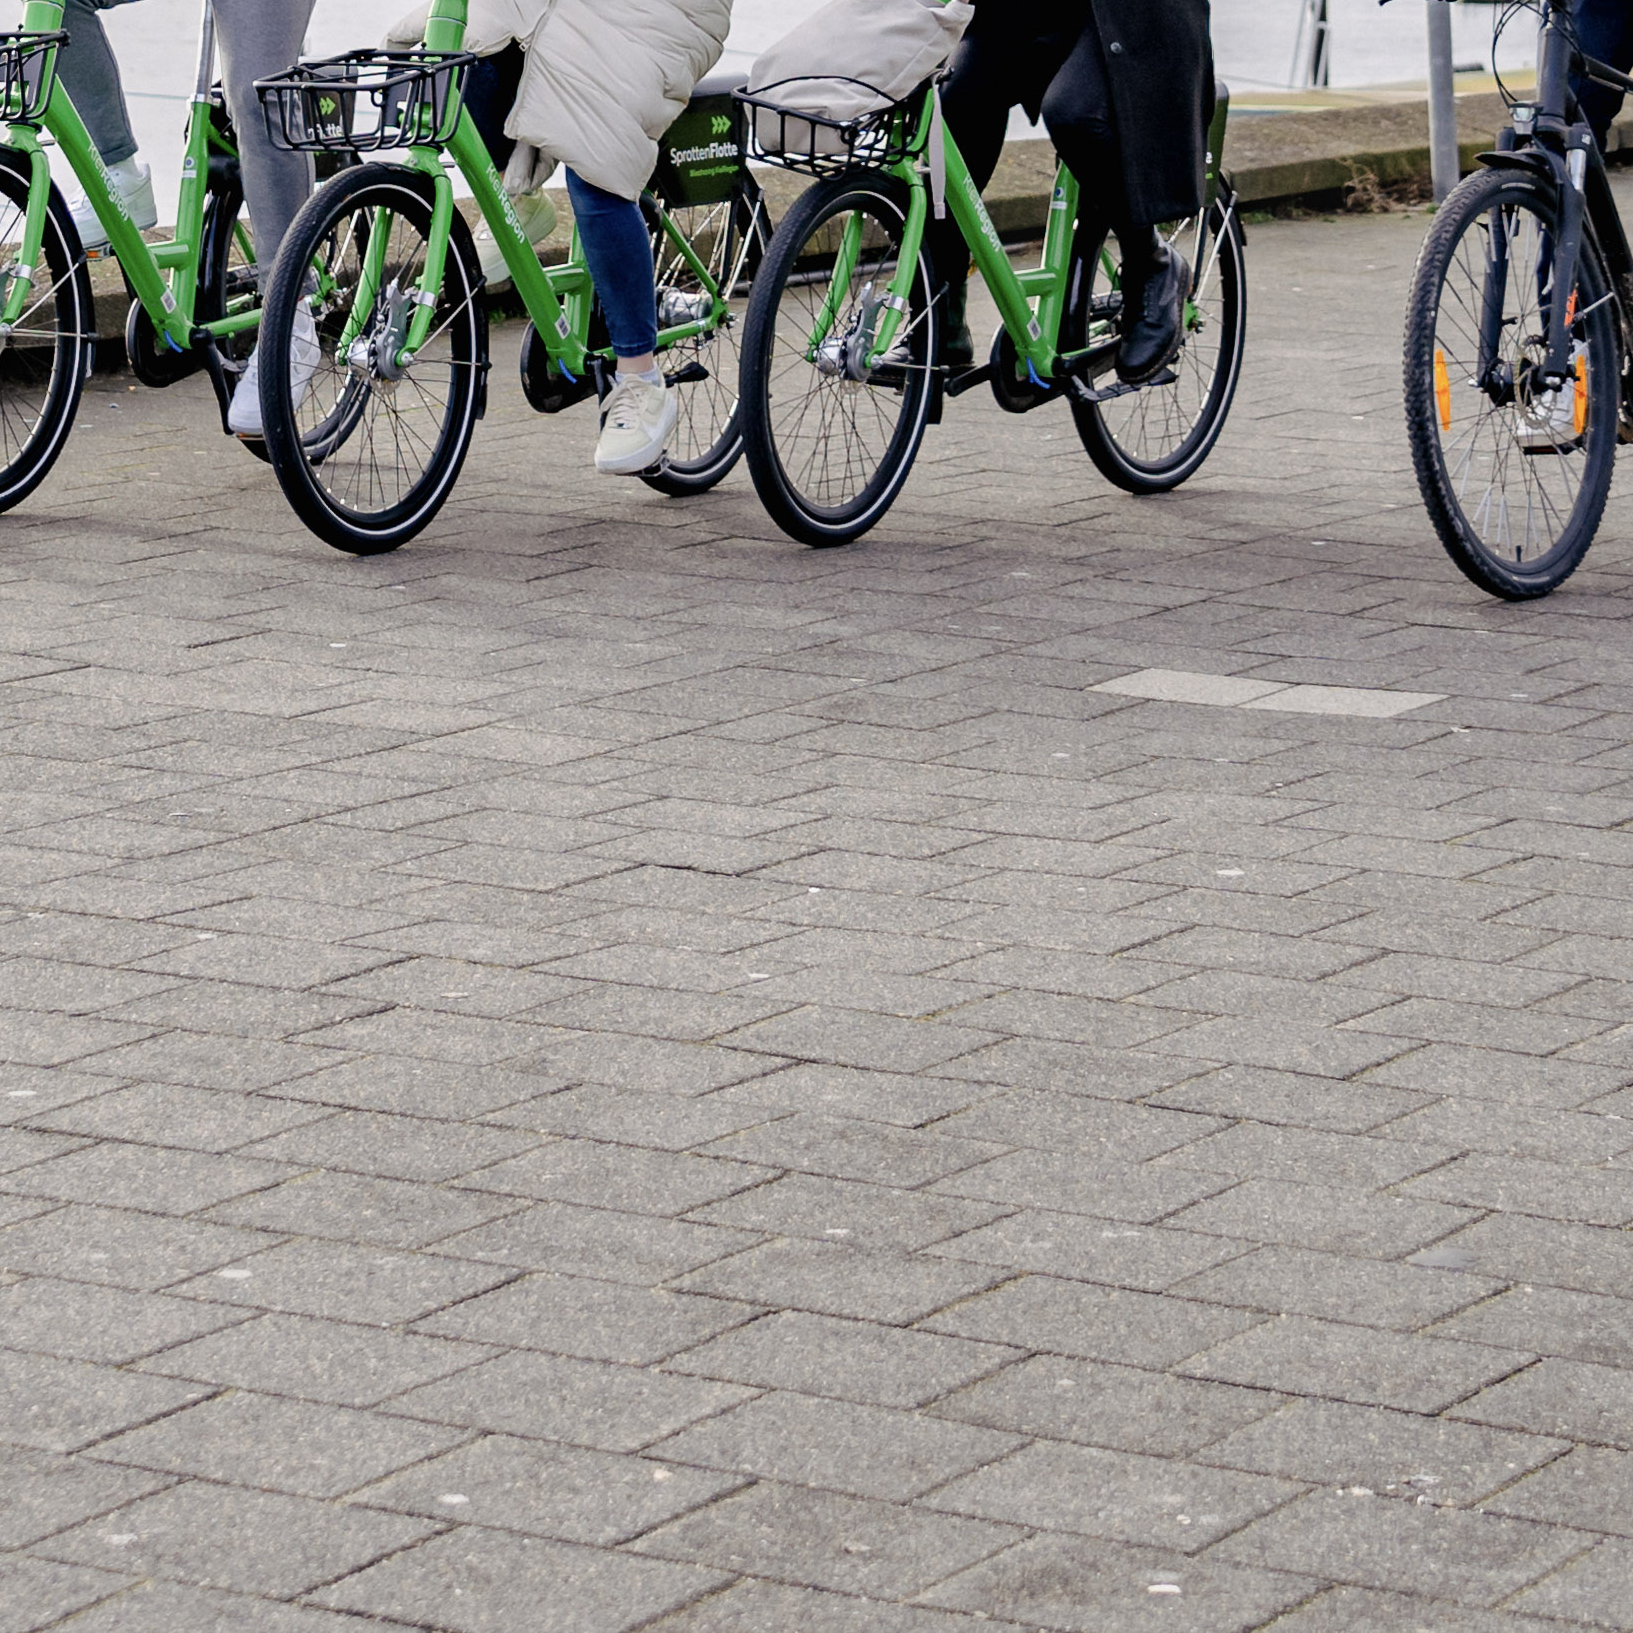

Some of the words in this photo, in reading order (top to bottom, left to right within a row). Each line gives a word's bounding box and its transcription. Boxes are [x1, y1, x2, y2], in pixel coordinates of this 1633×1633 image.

[88, 142, 129, 221] KielRegion
[670, 142, 738, 166] SprottenFlotte
[486, 162, 525, 244] KielRegion
